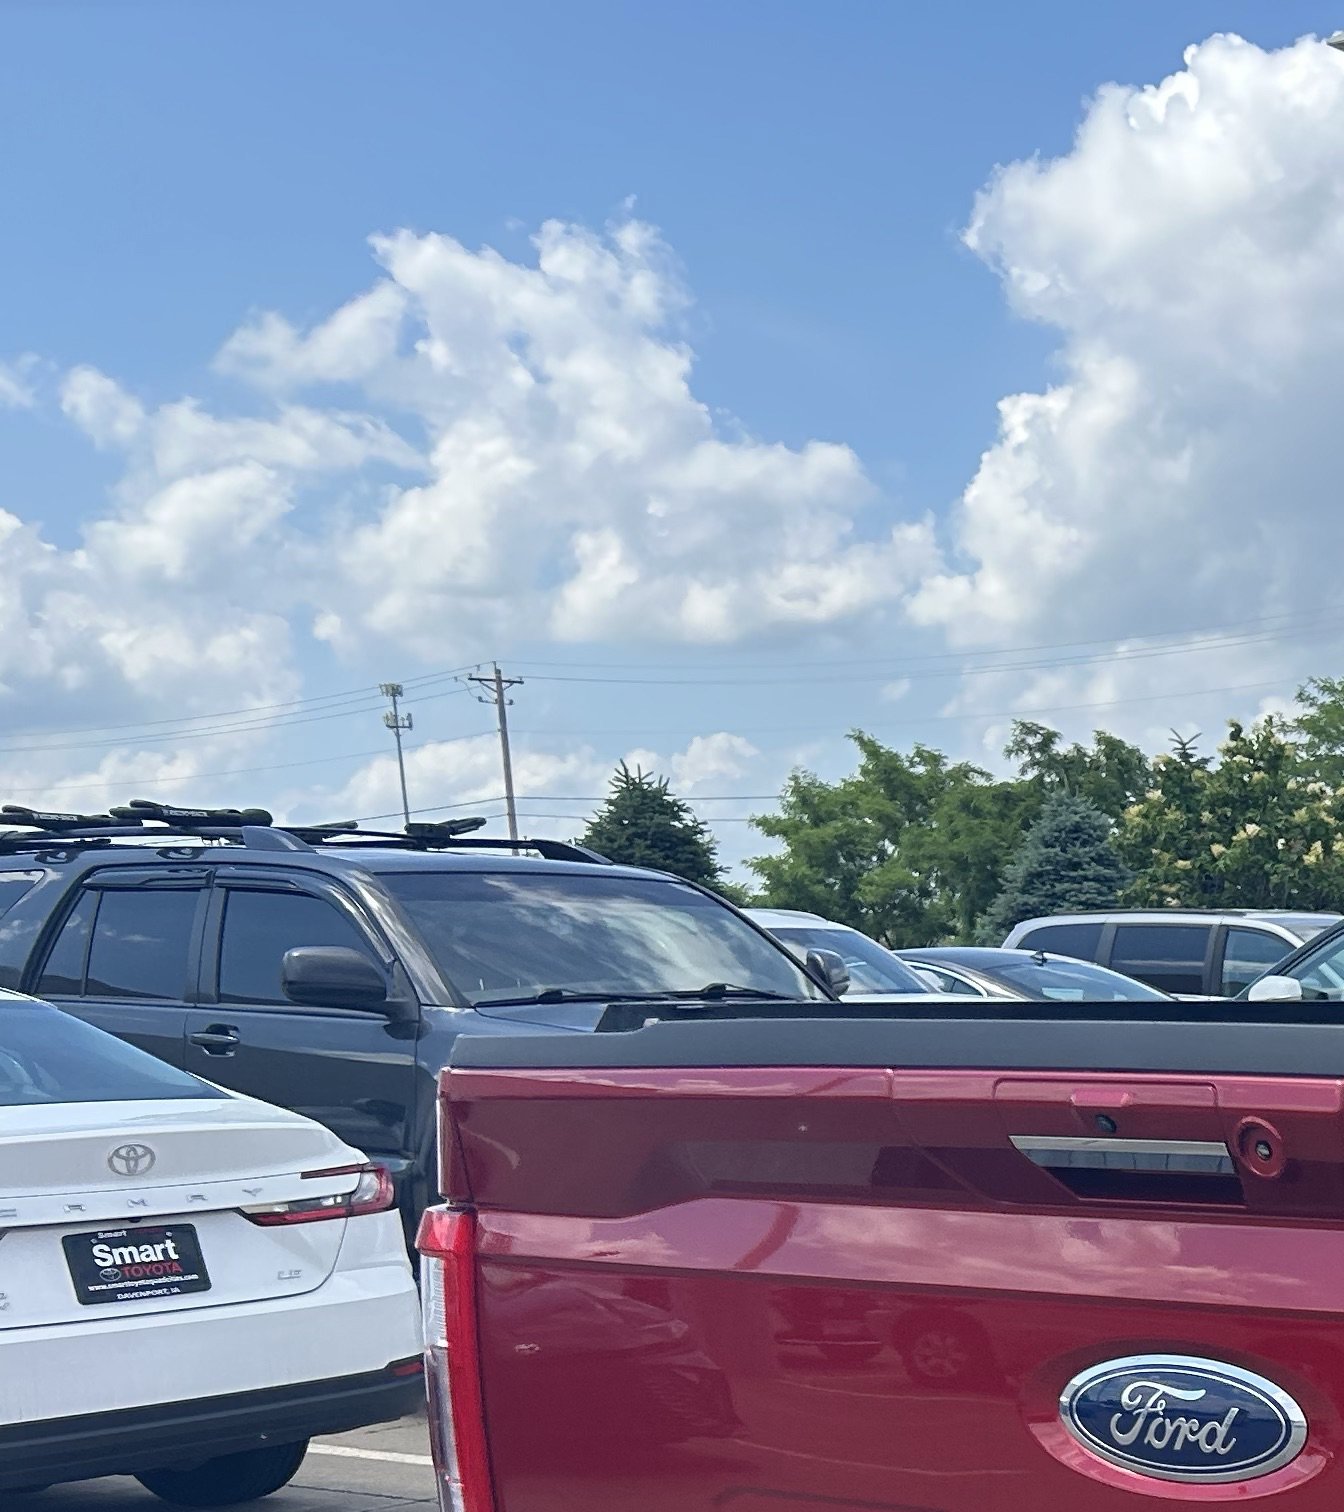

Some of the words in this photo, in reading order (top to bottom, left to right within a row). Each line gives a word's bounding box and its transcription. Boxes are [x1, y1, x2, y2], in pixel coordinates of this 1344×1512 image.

[97, 1230, 127, 1239] Smart
[92, 1238, 180, 1267] Smart
[121, 1262, 183, 1278] TOYOTA
[1110, 1380, 1239, 1455] Ford
